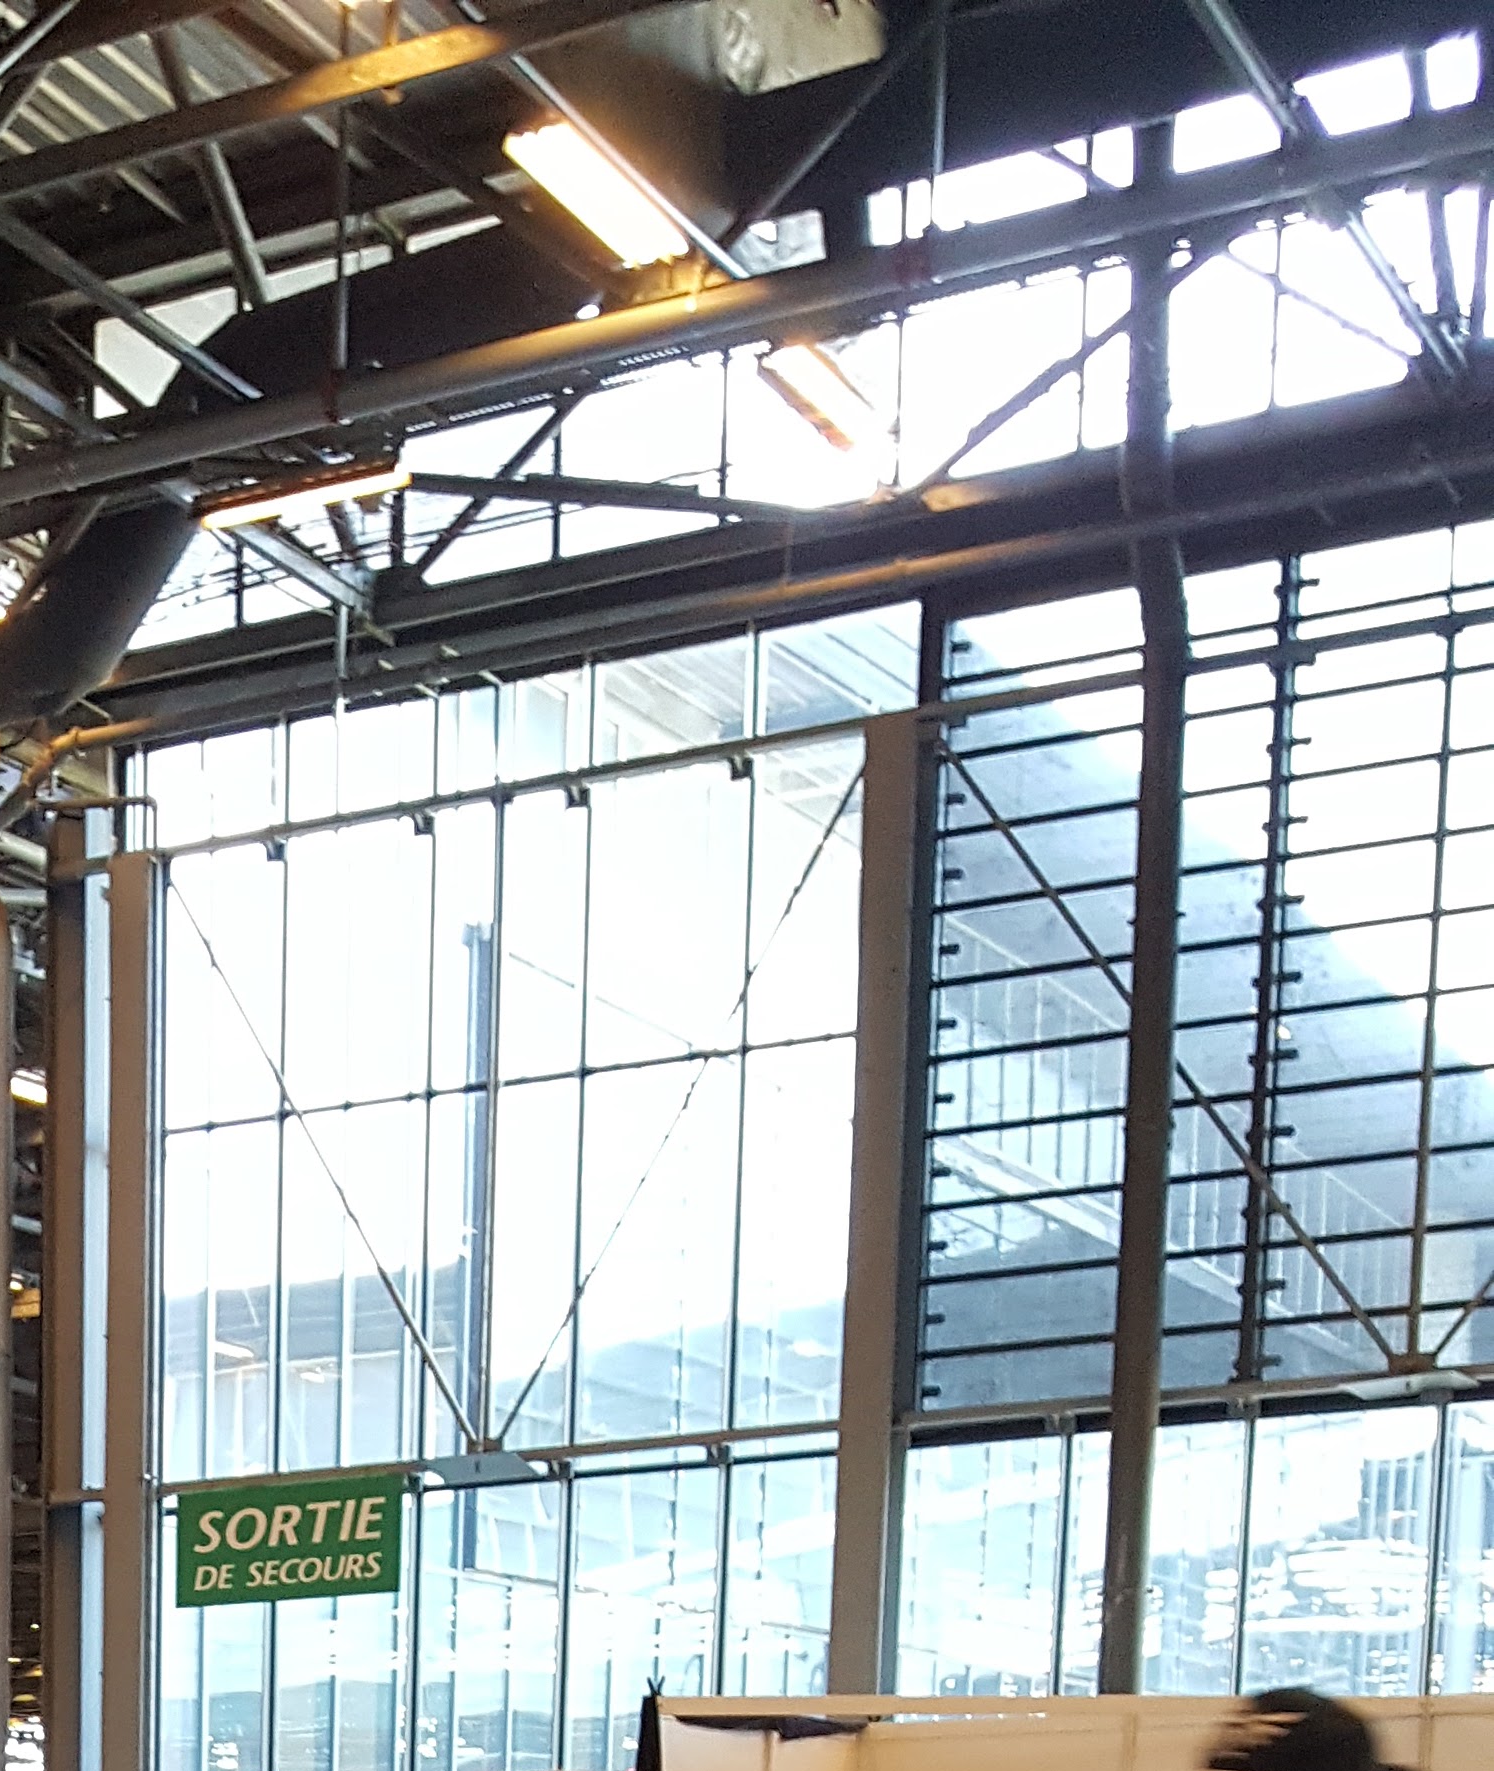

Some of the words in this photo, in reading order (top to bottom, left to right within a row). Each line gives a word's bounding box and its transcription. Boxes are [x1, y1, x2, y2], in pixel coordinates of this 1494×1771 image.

[193, 1496, 386, 1554] SORTIE
[193, 1563, 235, 1592] DE
[246, 1551, 383, 1588] SECOURS
